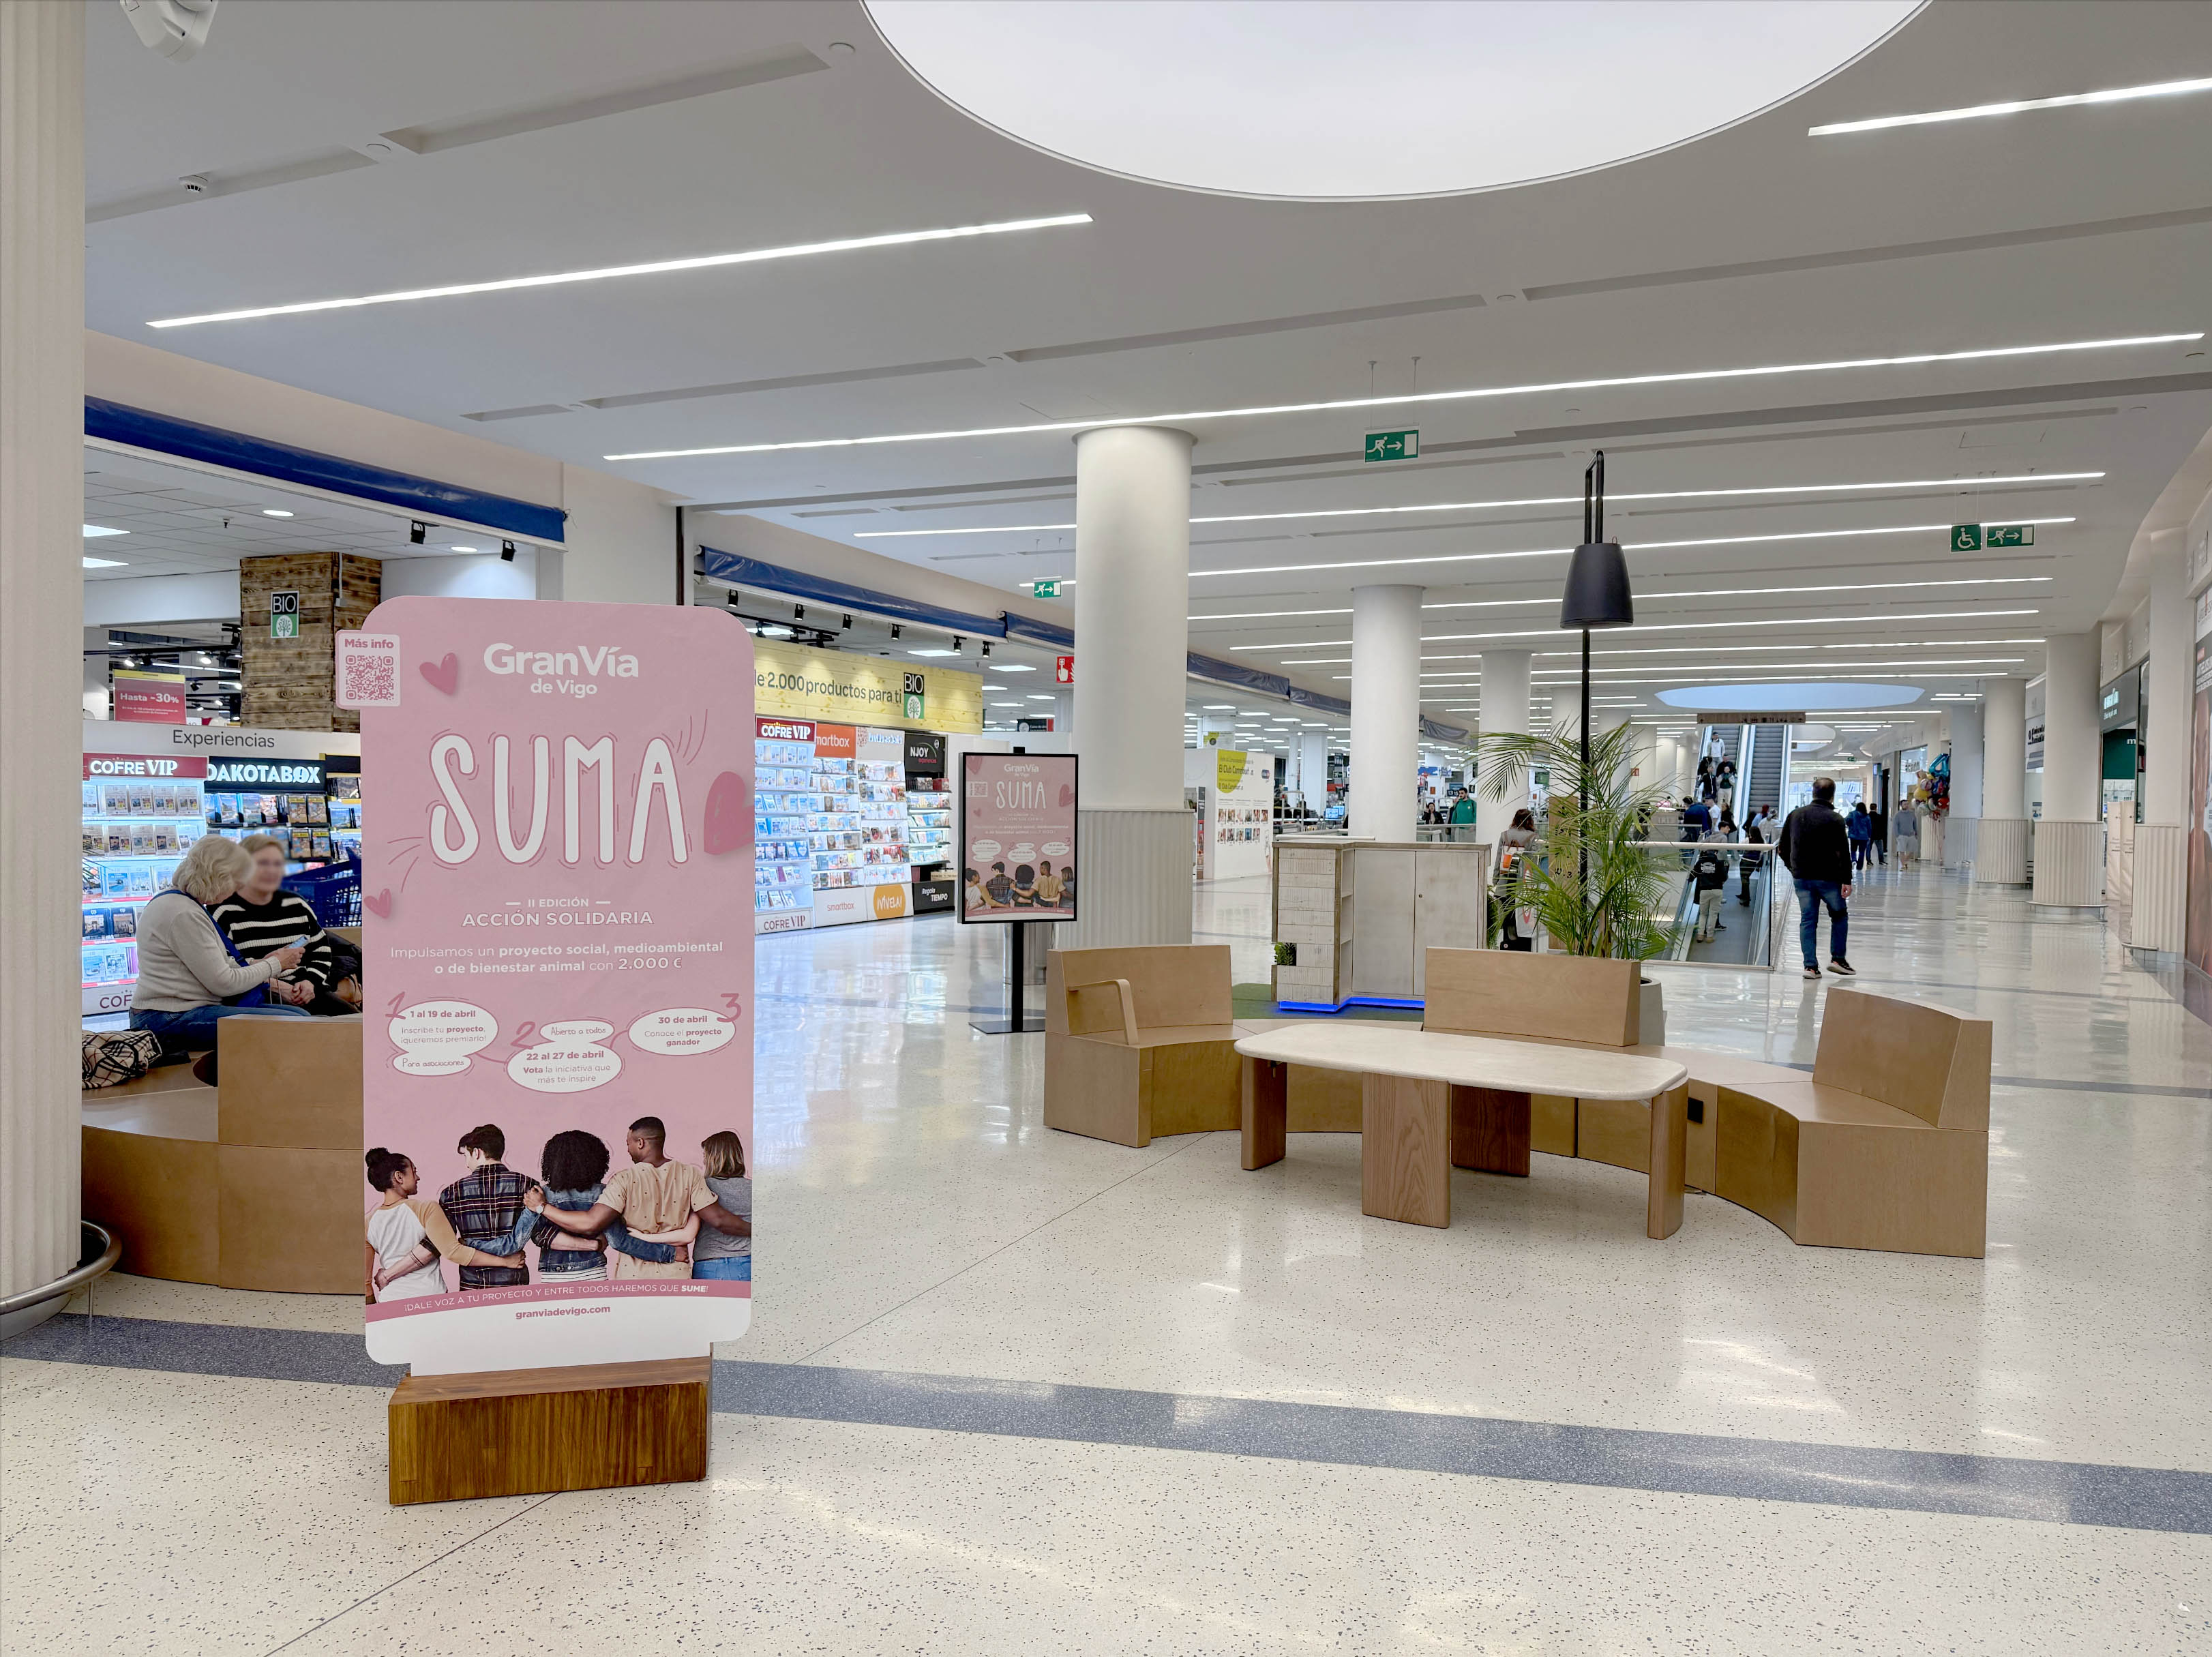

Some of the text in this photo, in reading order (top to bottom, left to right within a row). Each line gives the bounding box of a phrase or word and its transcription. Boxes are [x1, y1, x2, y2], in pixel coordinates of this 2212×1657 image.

[273, 595, 297, 613] BIO
[344, 638, 394, 649] Más info
[483, 642, 639, 678] GranVía
[530, 678, 597, 698] de Vigo
[768, 672, 804, 691] 2.000
[806, 680, 865, 699] productos
[869, 689, 893, 704] para
[895, 689, 901, 704] ti
[905, 674, 923, 693] BIO
[120, 693, 179, 703] Hasta -30%
[173, 730, 275, 747] Experiencias
[762, 725, 810, 739] COFRE VIP
[816, 734, 850, 747] martbox
[910, 747, 929, 757] NJOY
[91, 760, 177, 776] COFRE VIP
[429, 734, 689, 865] SUMA
[996, 781, 1046, 809] SUMA
[539, 897, 588, 908] EDICIÓN
[931, 893, 948, 901] TIEMPO
[827, 901, 854, 911] smartbox
[462, 910, 653, 927] ACCIÓN SOLIDARIA
[764, 915, 805, 931] COFRE VIP
[391, 947, 473, 959] Impulsamos
[499, 945, 562, 957] proyecto
[567, 944, 610, 956] social,
[614, 942, 723, 954] medioambiental
[435, 957, 682, 974] o de bienestar animal con 2.000 €
[385, 991, 406, 1019] 1
[717, 993, 741, 1022] 3
[447, 1026, 485, 1034] proyecto,
[511, 1021, 535, 1049] 2
[551, 1027, 576, 1035] Abierto
[401, 1036, 443, 1045] ¡queremos
[402, 1058, 420, 1067] Para
[404, 1302, 432, 1312] ¡DALE
[435, 1298, 454, 1307] VOZ
[483, 1289, 533, 1301] PROYECTO
[545, 1287, 574, 1296] ENTRE
[515, 1306, 610, 1319] granviadevigo.com
